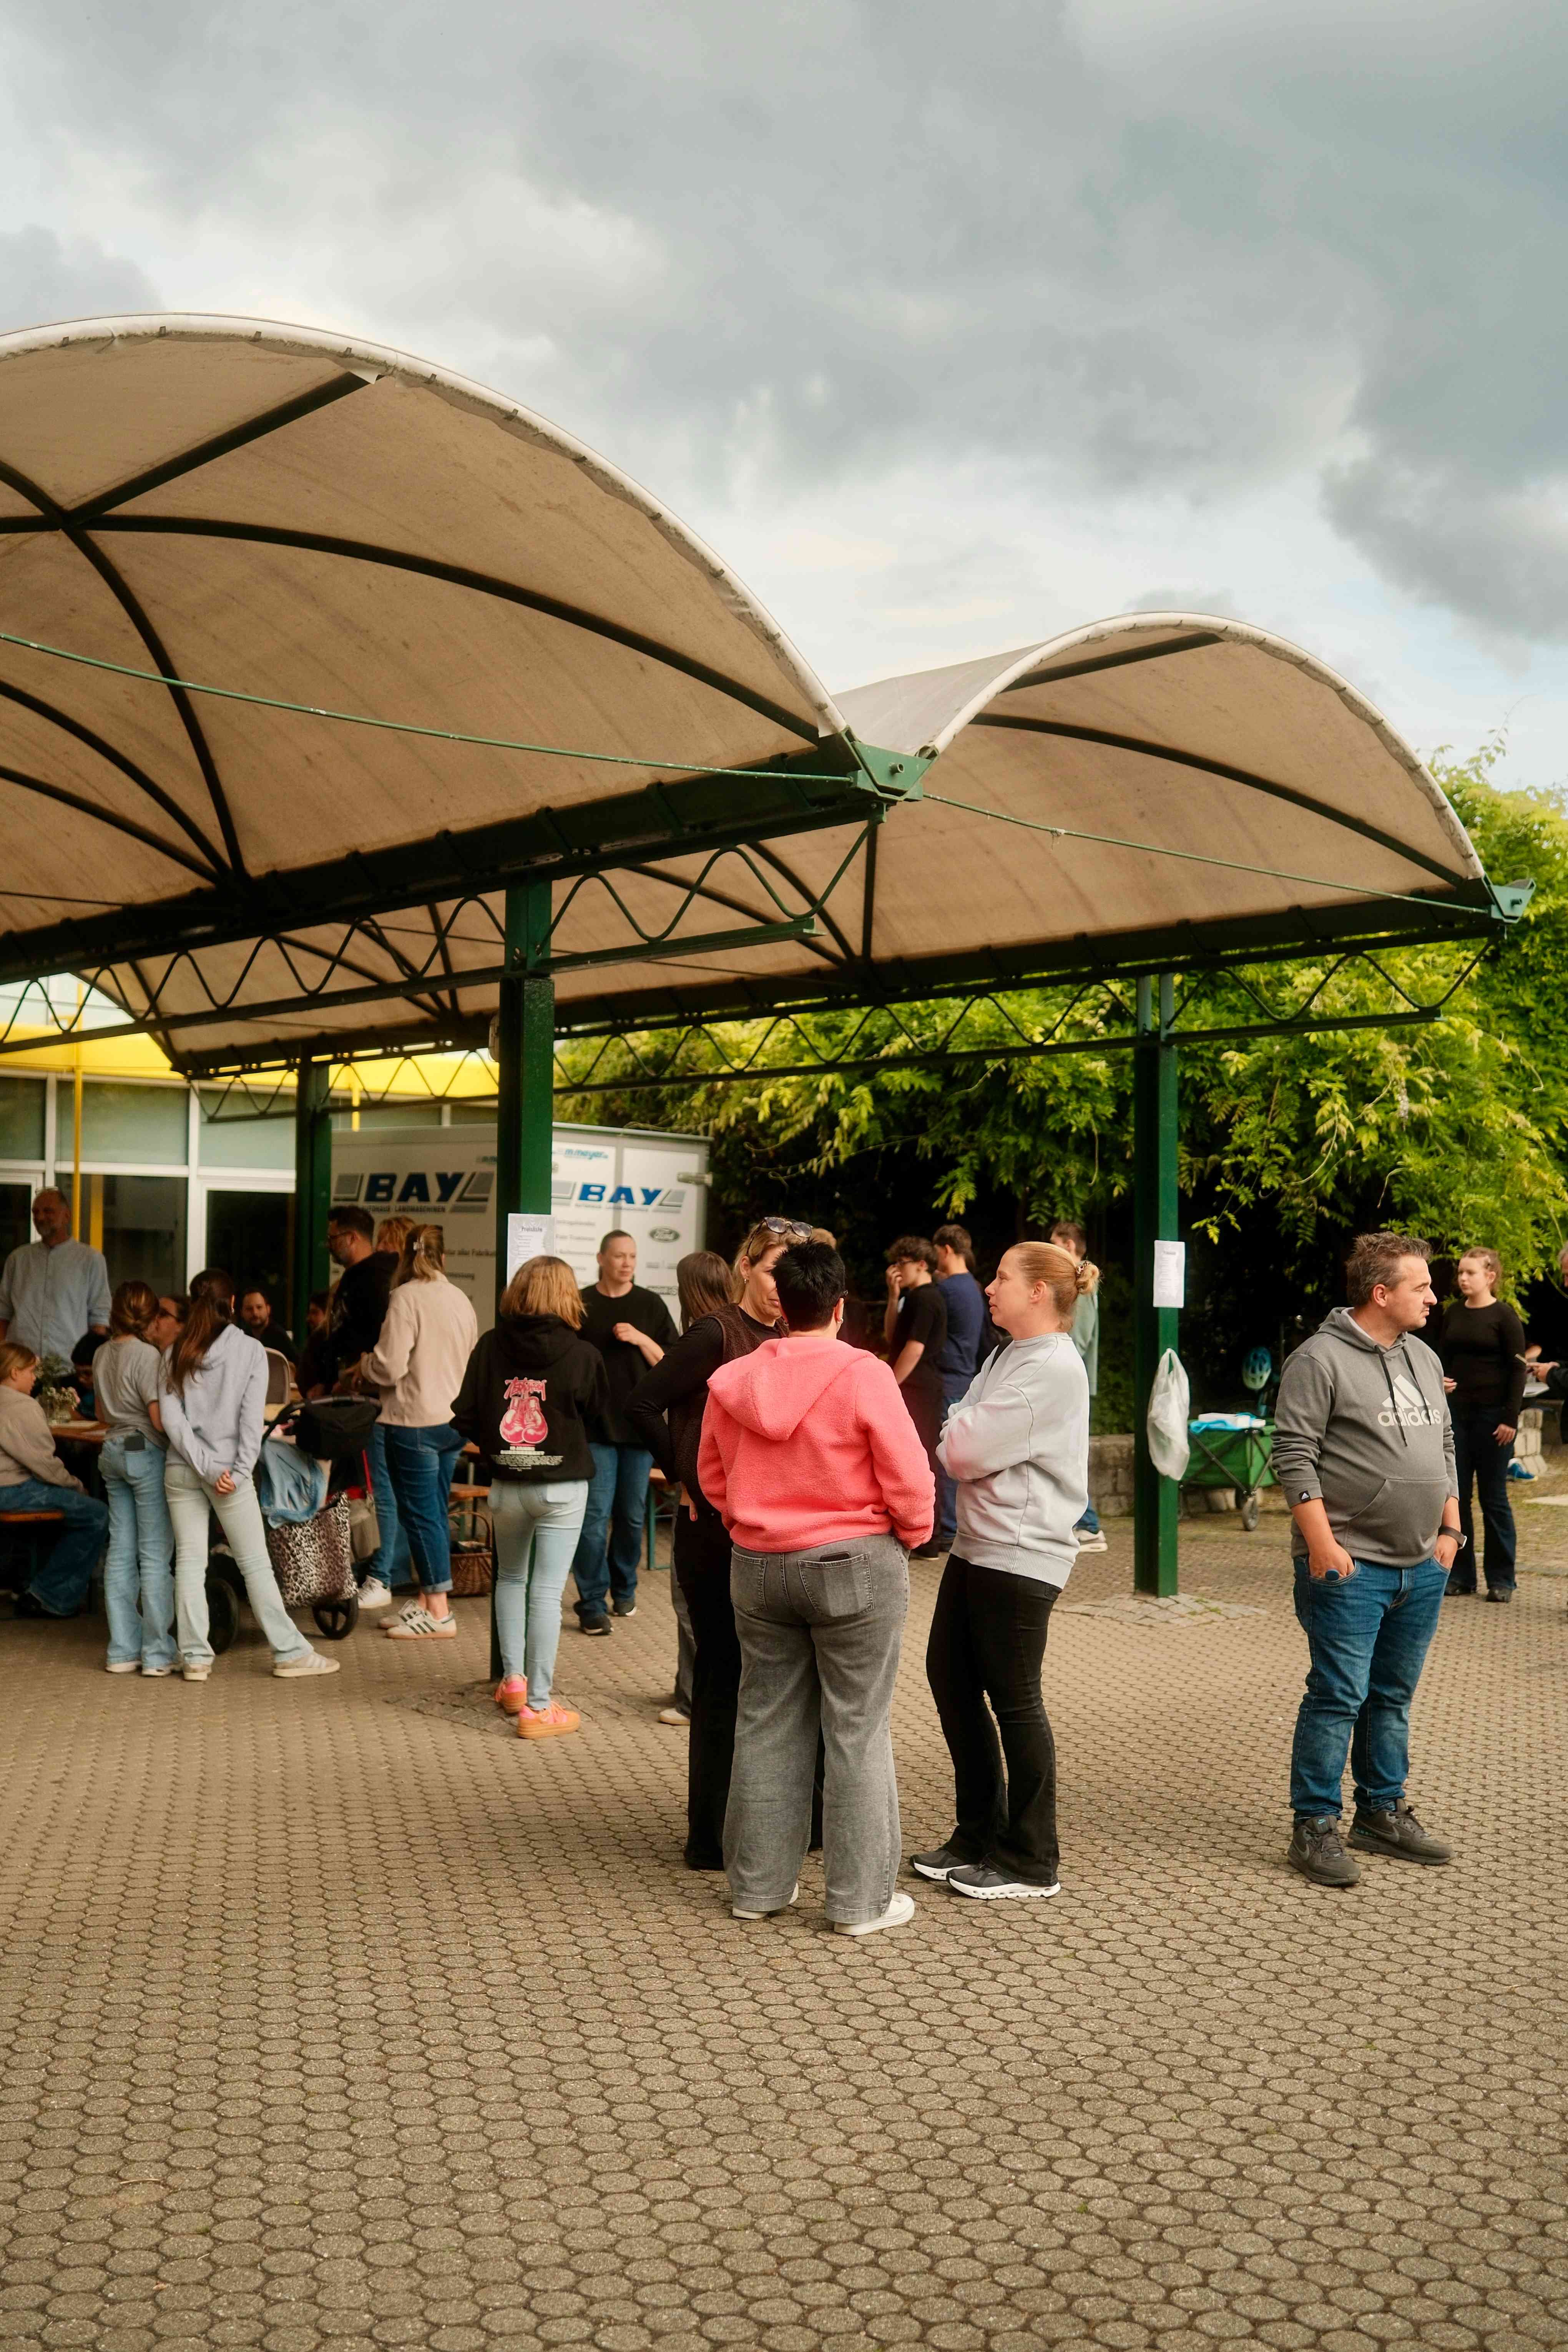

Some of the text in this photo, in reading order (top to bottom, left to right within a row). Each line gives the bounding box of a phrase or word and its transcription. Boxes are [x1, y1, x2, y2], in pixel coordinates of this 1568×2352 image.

[364, 1172, 464, 1202] BAY
[578, 1183, 663, 1205] BAY
[1377, 1406, 1441, 1427] adidas
